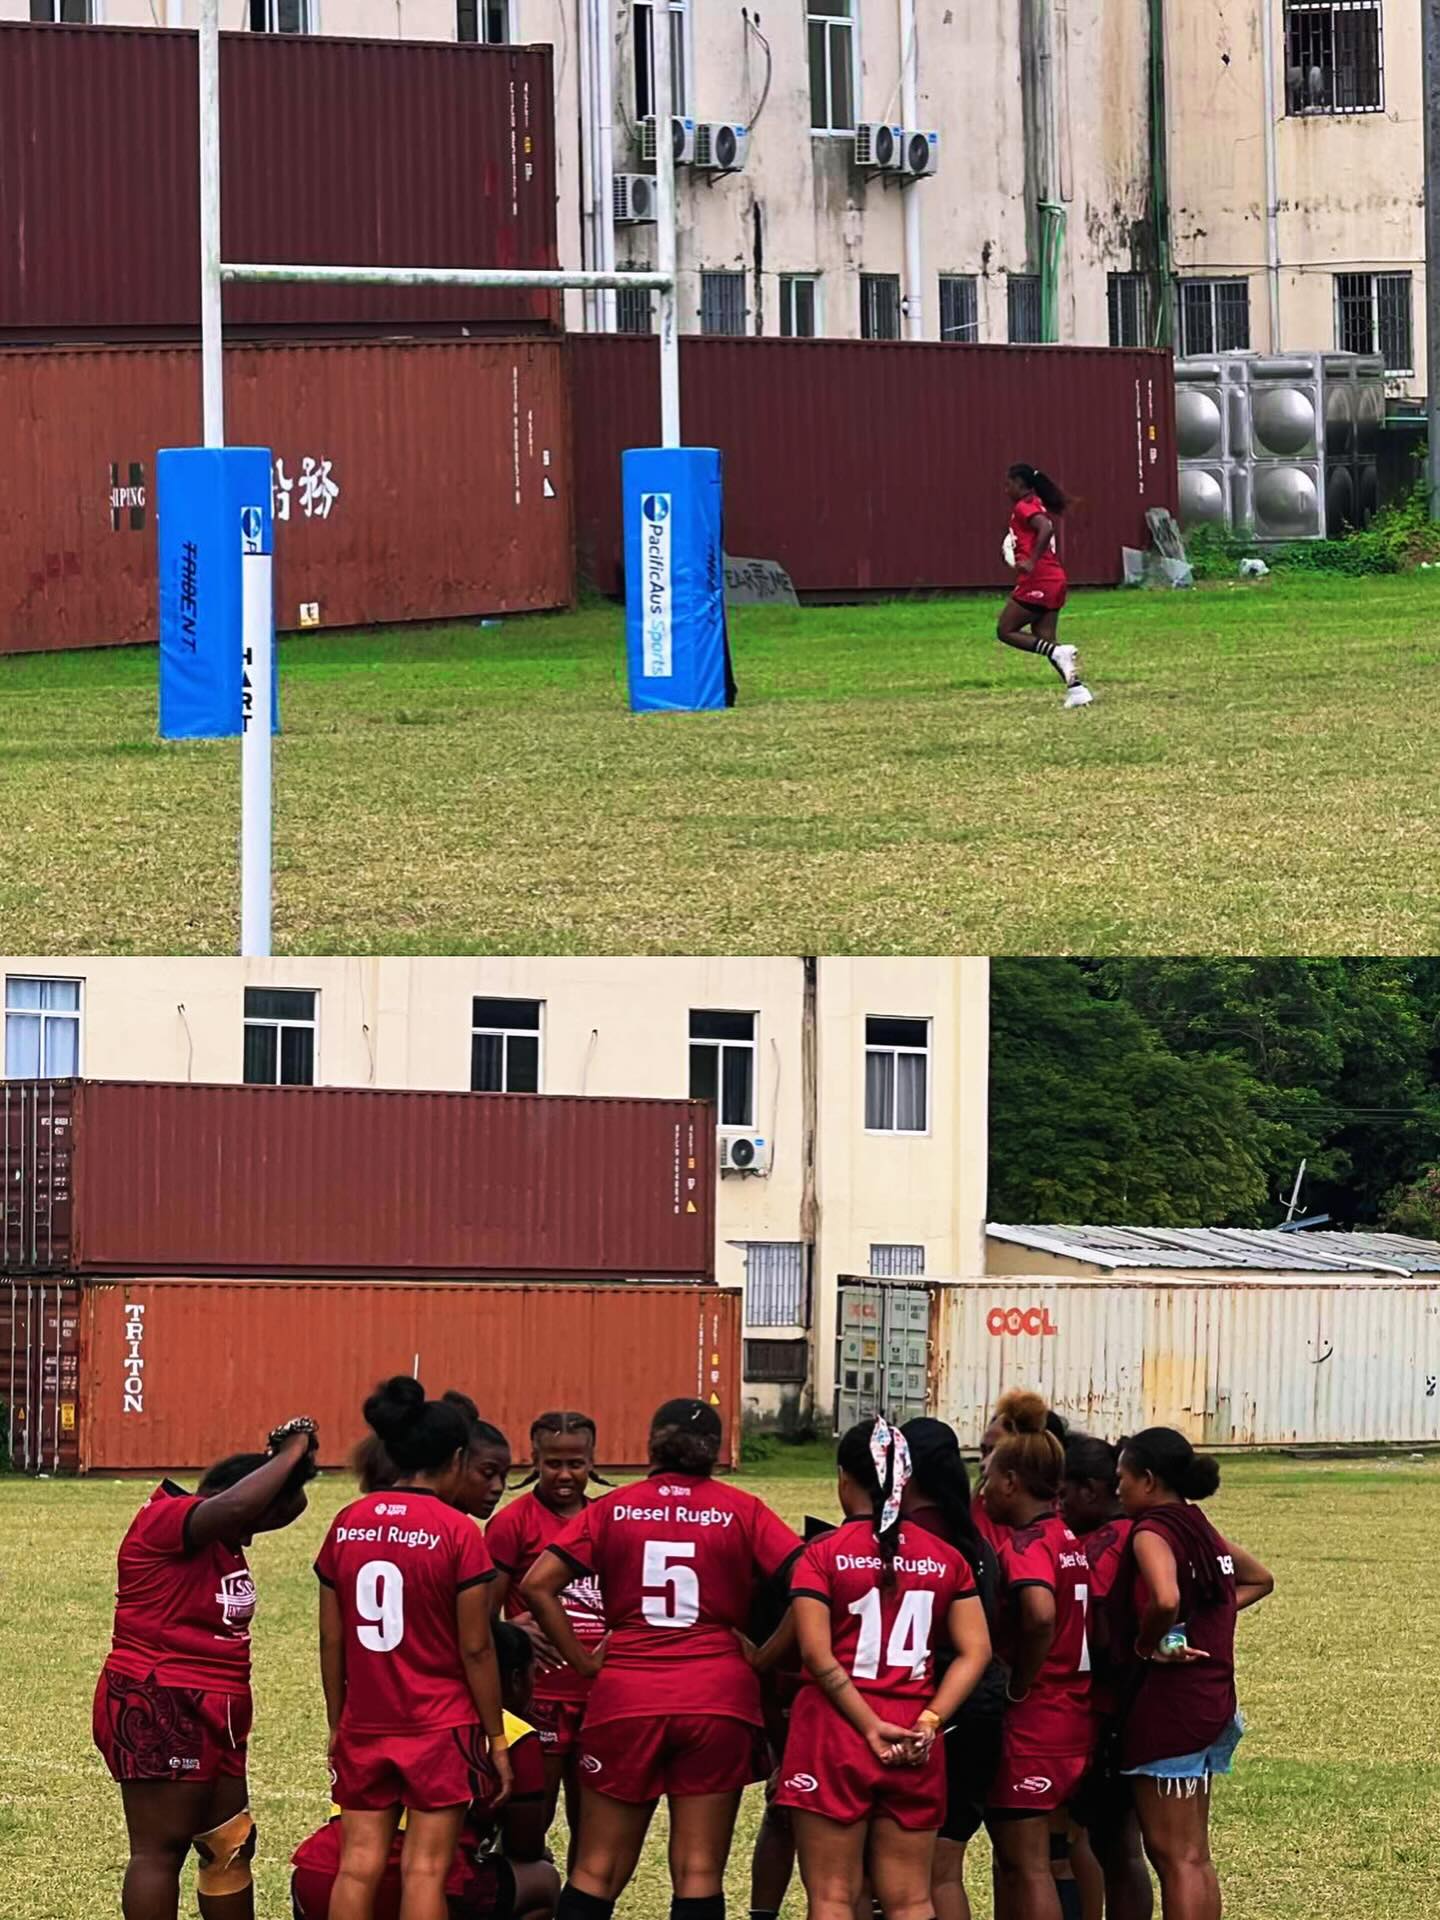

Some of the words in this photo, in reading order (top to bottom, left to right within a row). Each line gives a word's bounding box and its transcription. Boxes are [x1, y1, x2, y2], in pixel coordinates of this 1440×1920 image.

[648, 524, 665, 614] PacificAus
[647, 620, 665, 677] Sports
[986, 1307, 1058, 1336] OOCL
[123, 1304, 145, 1412] TRITON
[387, 1526, 440, 1550] Rugby
[613, 1505, 669, 1521] Diesel
[676, 1506, 733, 1527] Rugby
[641, 1540, 699, 1628] 5
[835, 1554, 887, 1571] Diese
[893, 1556, 947, 1578] Rugby
[356, 1560, 404, 1652] 9
[848, 1586, 935, 1681] 14
